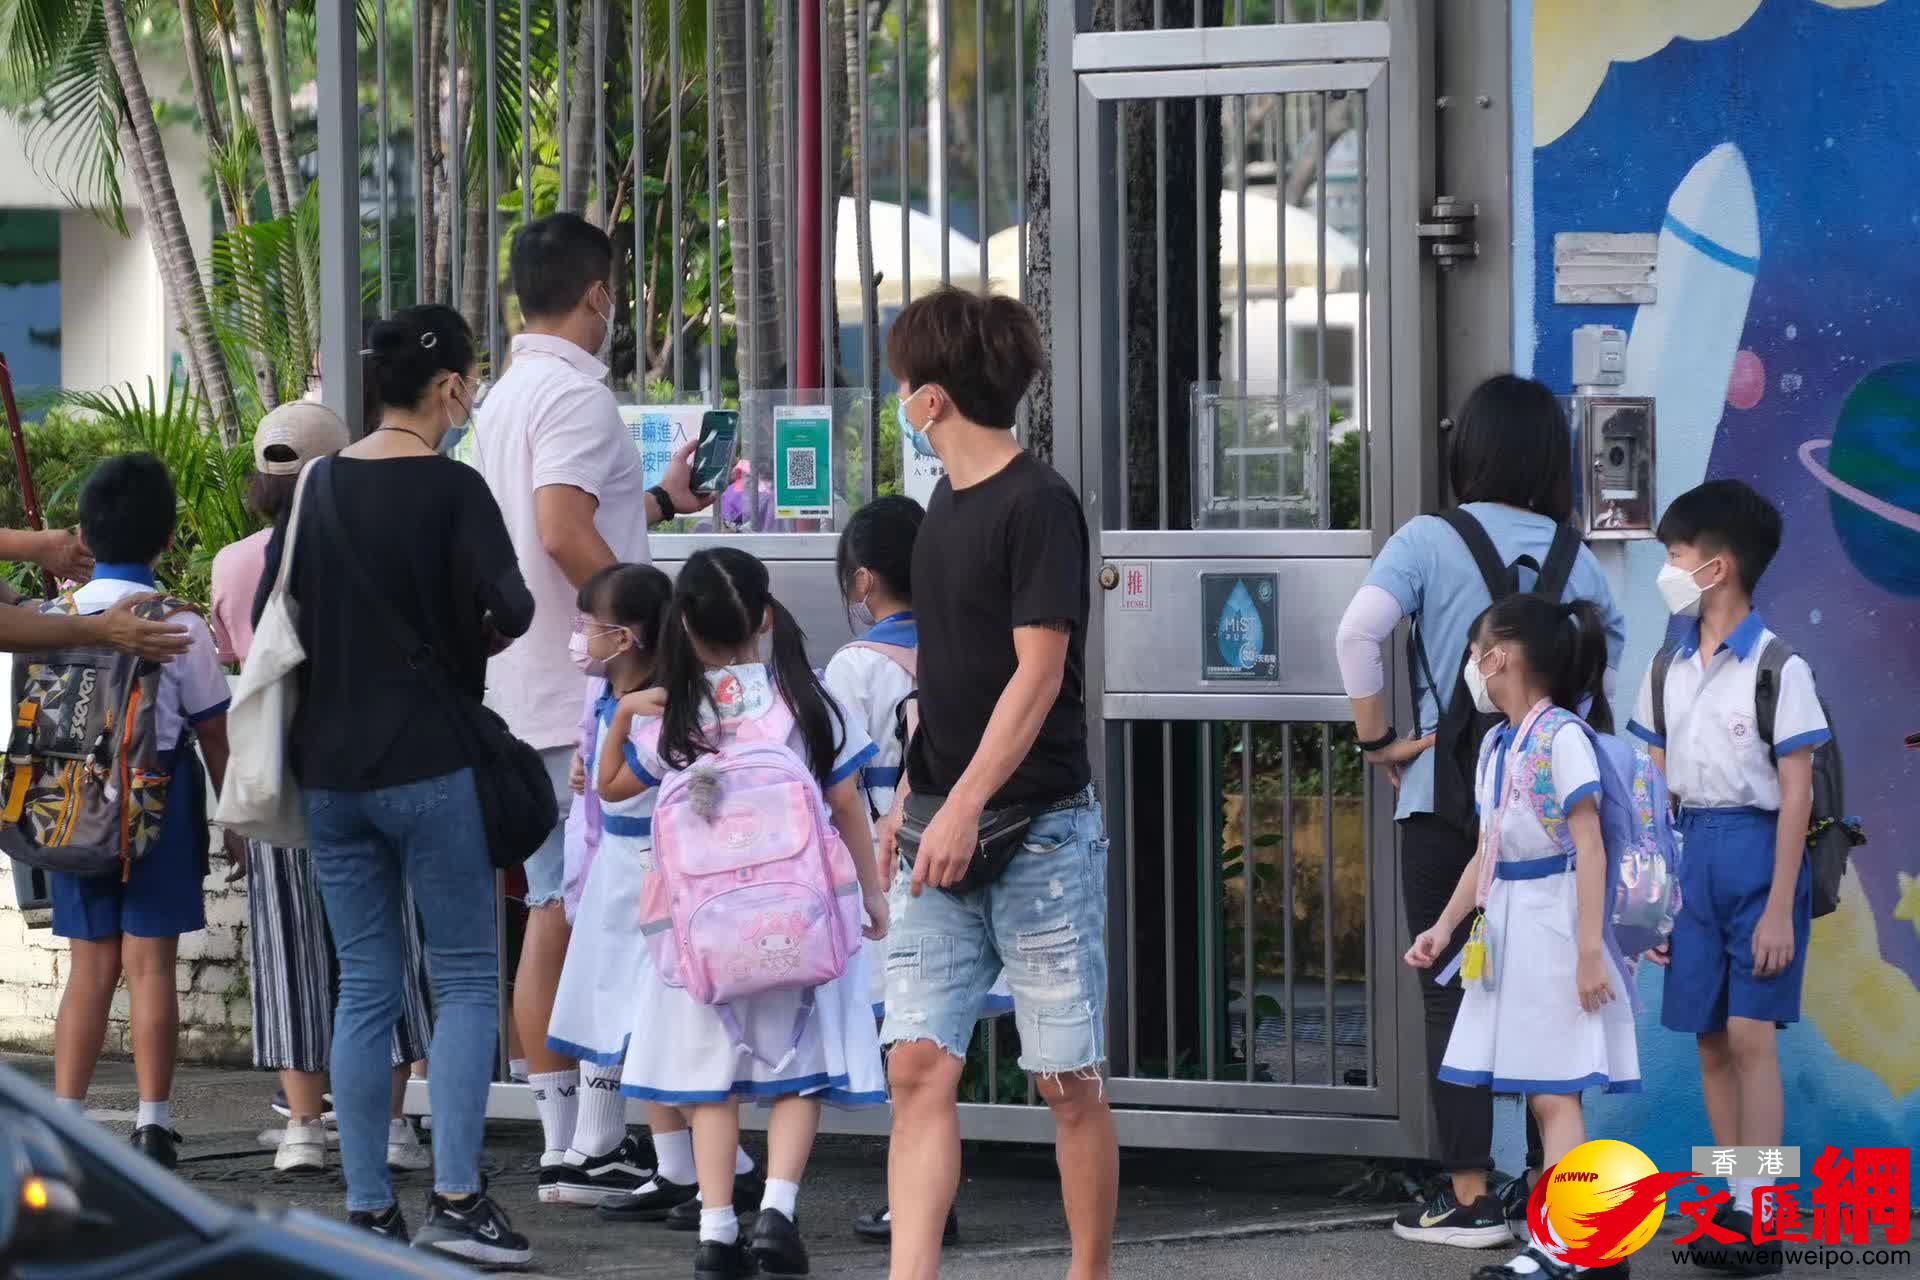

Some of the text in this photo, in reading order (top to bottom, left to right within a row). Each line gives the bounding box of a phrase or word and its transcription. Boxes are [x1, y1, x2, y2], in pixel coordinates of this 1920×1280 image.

[642, 451, 678, 472] 按門
[1127, 569, 1143, 595] 推
[585, 1076, 621, 1091] VAN
